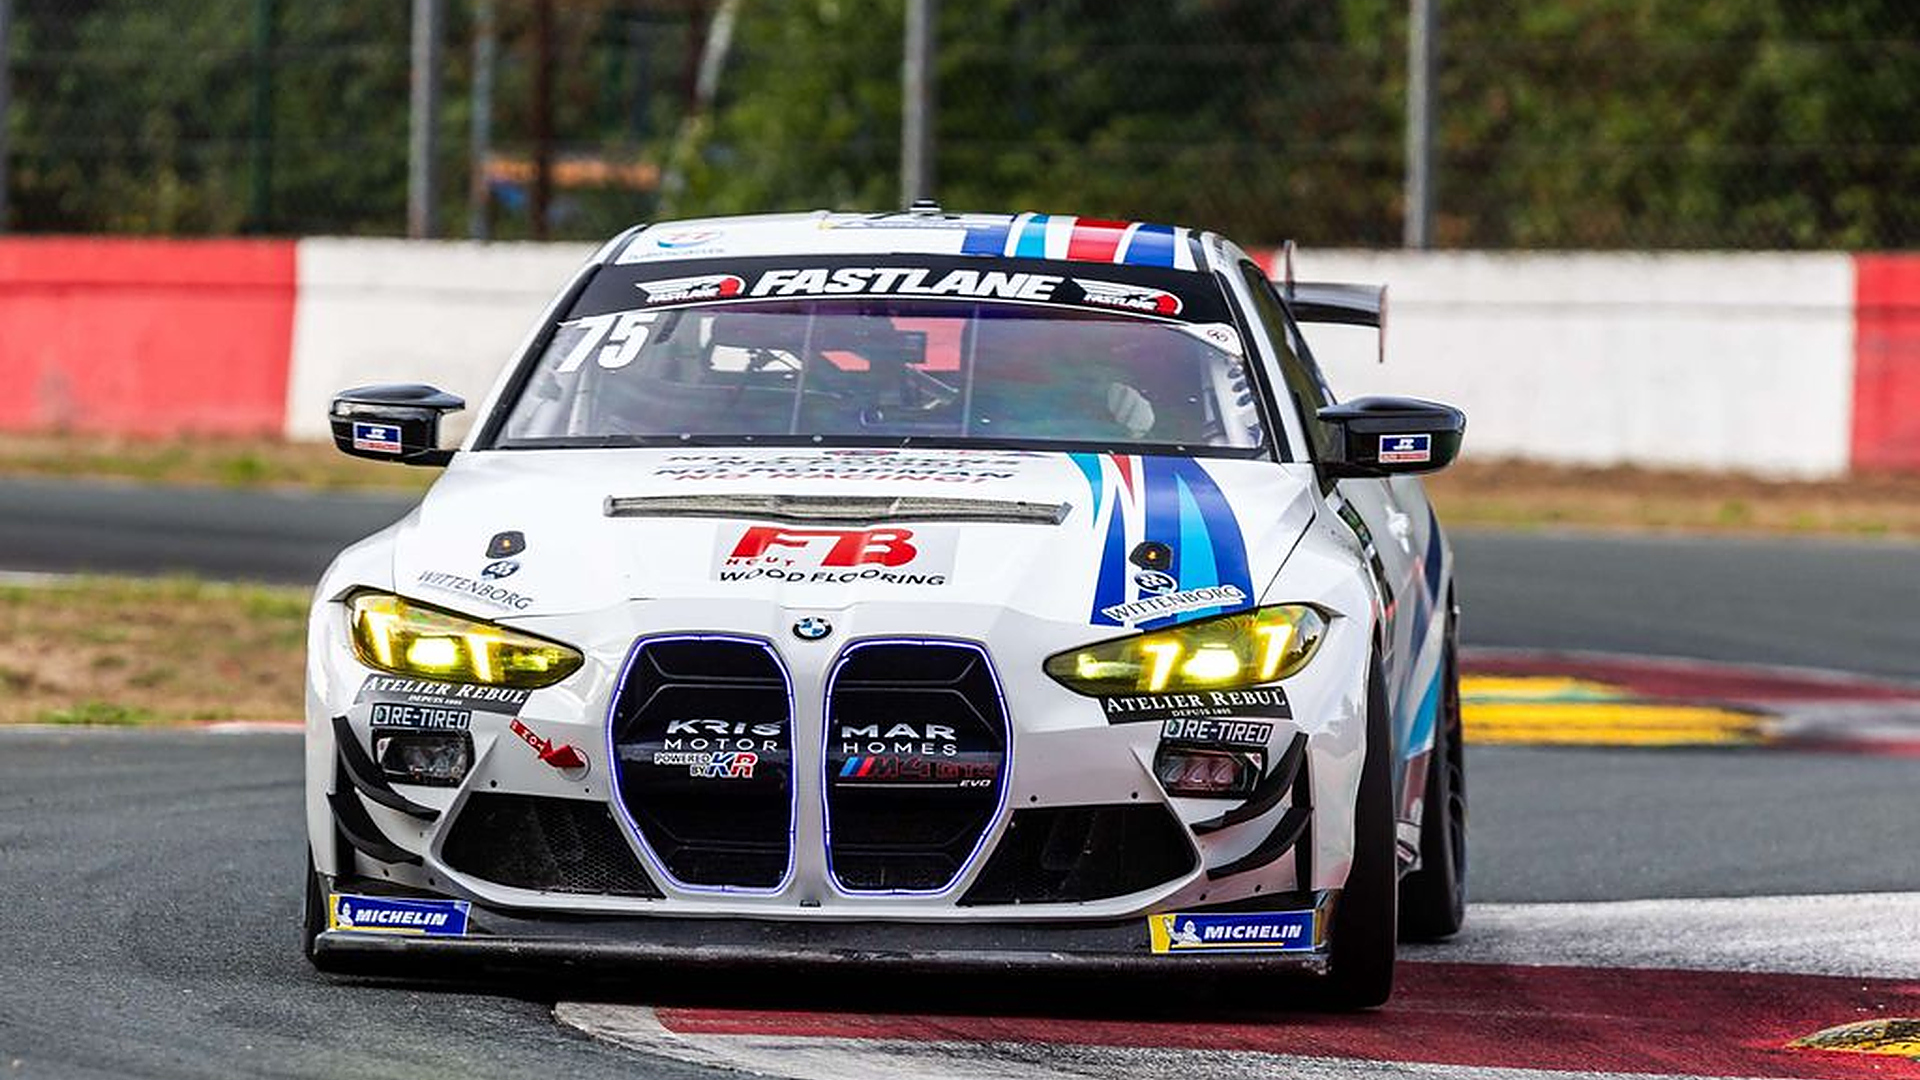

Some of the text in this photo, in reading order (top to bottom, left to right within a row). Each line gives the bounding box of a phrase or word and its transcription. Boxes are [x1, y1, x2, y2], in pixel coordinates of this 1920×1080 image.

[750, 268, 1064, 300] FASTLANE
[646, 287, 719, 303] FASTLANE
[1083, 293, 1157, 311] FASTLANE
[557, 312, 658, 373] 75
[719, 568, 946, 586] WOOD FLOORING
[418, 570, 534, 611] WITTENBORG
[1108, 585, 1242, 619] WITTENBORG
[362, 676, 529, 704] ATELIER REBUL
[1106, 690, 1286, 714] ATELIER REBUL
[390, 706, 470, 729] RE-TIRED
[666, 719, 781, 736] KRIS
[841, 723, 957, 740] MAR
[1183, 720, 1272, 744] RE-TIRED
[664, 738, 778, 752] MOTOR
[843, 742, 957, 757] HOMES
[655, 752, 710, 765] POWERED
[690, 752, 758, 778] BY KR
[959, 779, 992, 787] EVO
[355, 909, 449, 926] MICHELIN
[1203, 924, 1302, 940] MICHELIN
